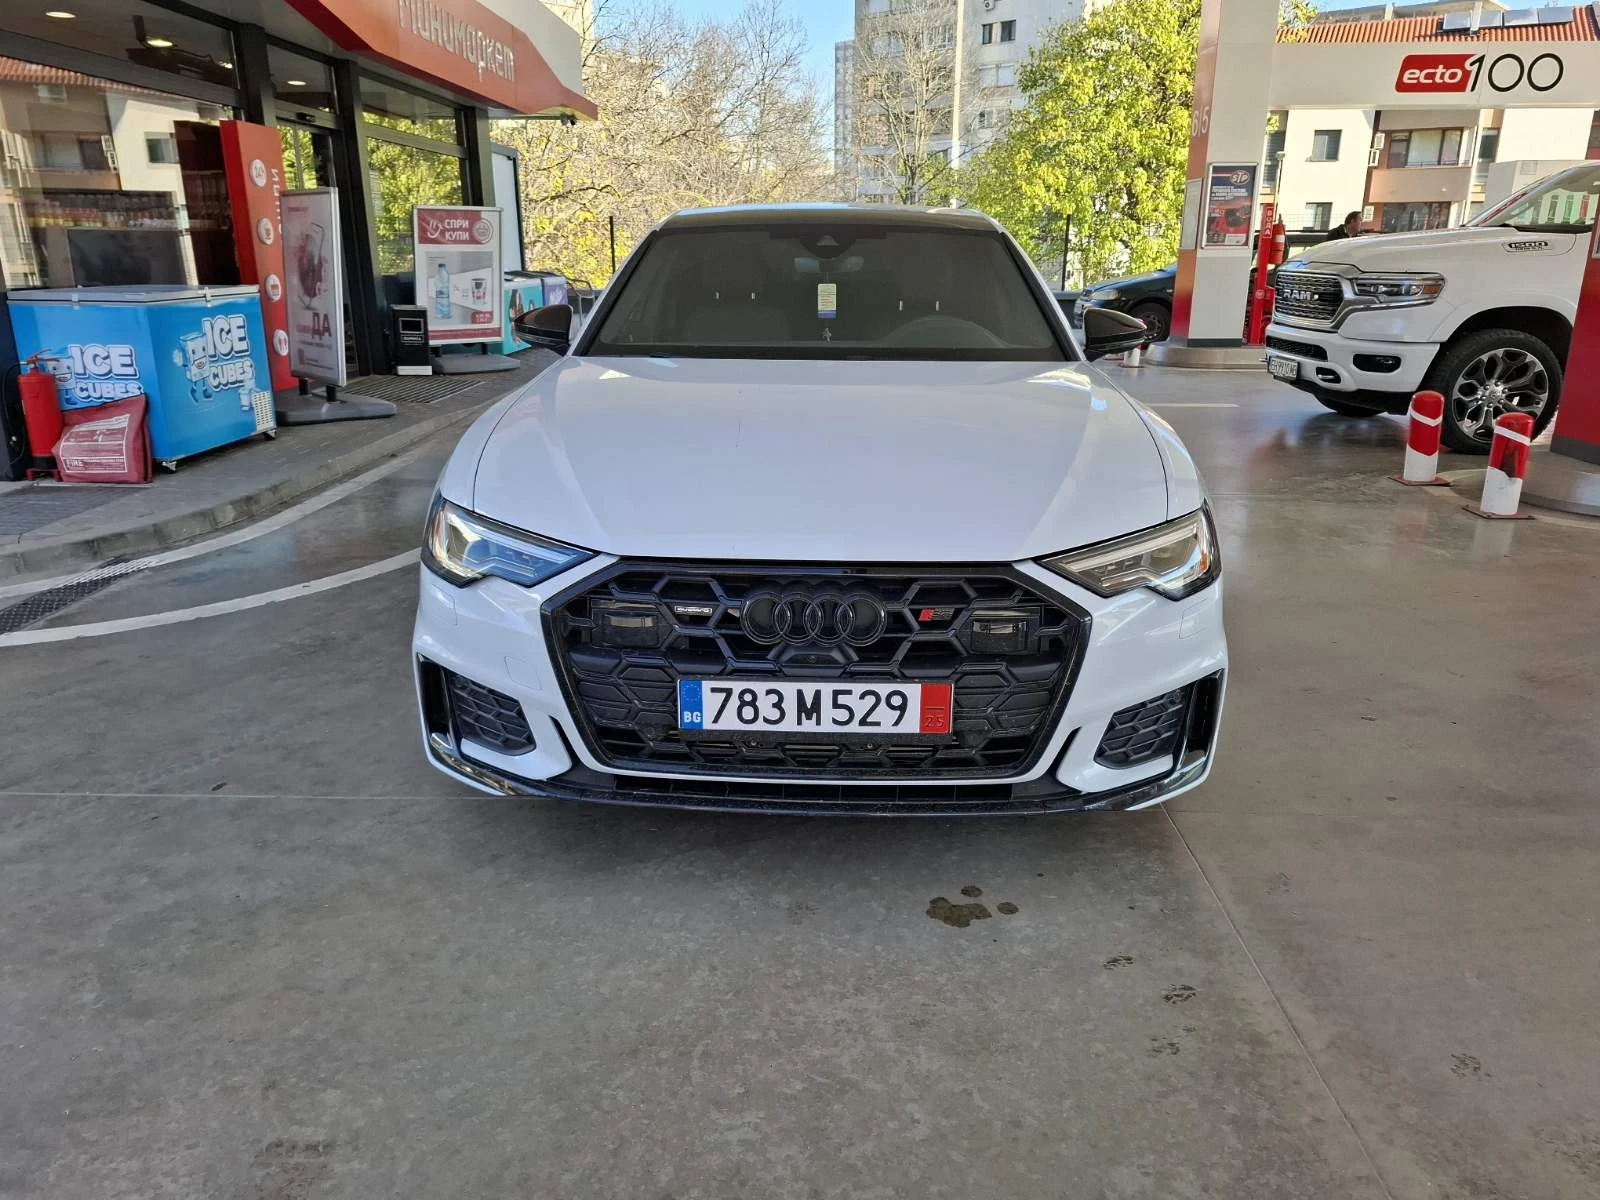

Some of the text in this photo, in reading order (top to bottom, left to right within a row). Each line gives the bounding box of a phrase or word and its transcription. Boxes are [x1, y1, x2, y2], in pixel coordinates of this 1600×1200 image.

[1232, 171, 1248, 183] STP
[444, 219, 469, 229] СПРИ
[445, 232, 470, 241] КУПИ
[1283, 289, 1311, 301] RAM
[204, 316, 249, 358] ICE
[70, 346, 138, 378] ICE
[210, 361, 252, 389] CUBES
[76, 383, 142, 400] CUBES
[710, 687, 908, 726] 783 M 529
[683, 711, 701, 723] BG
